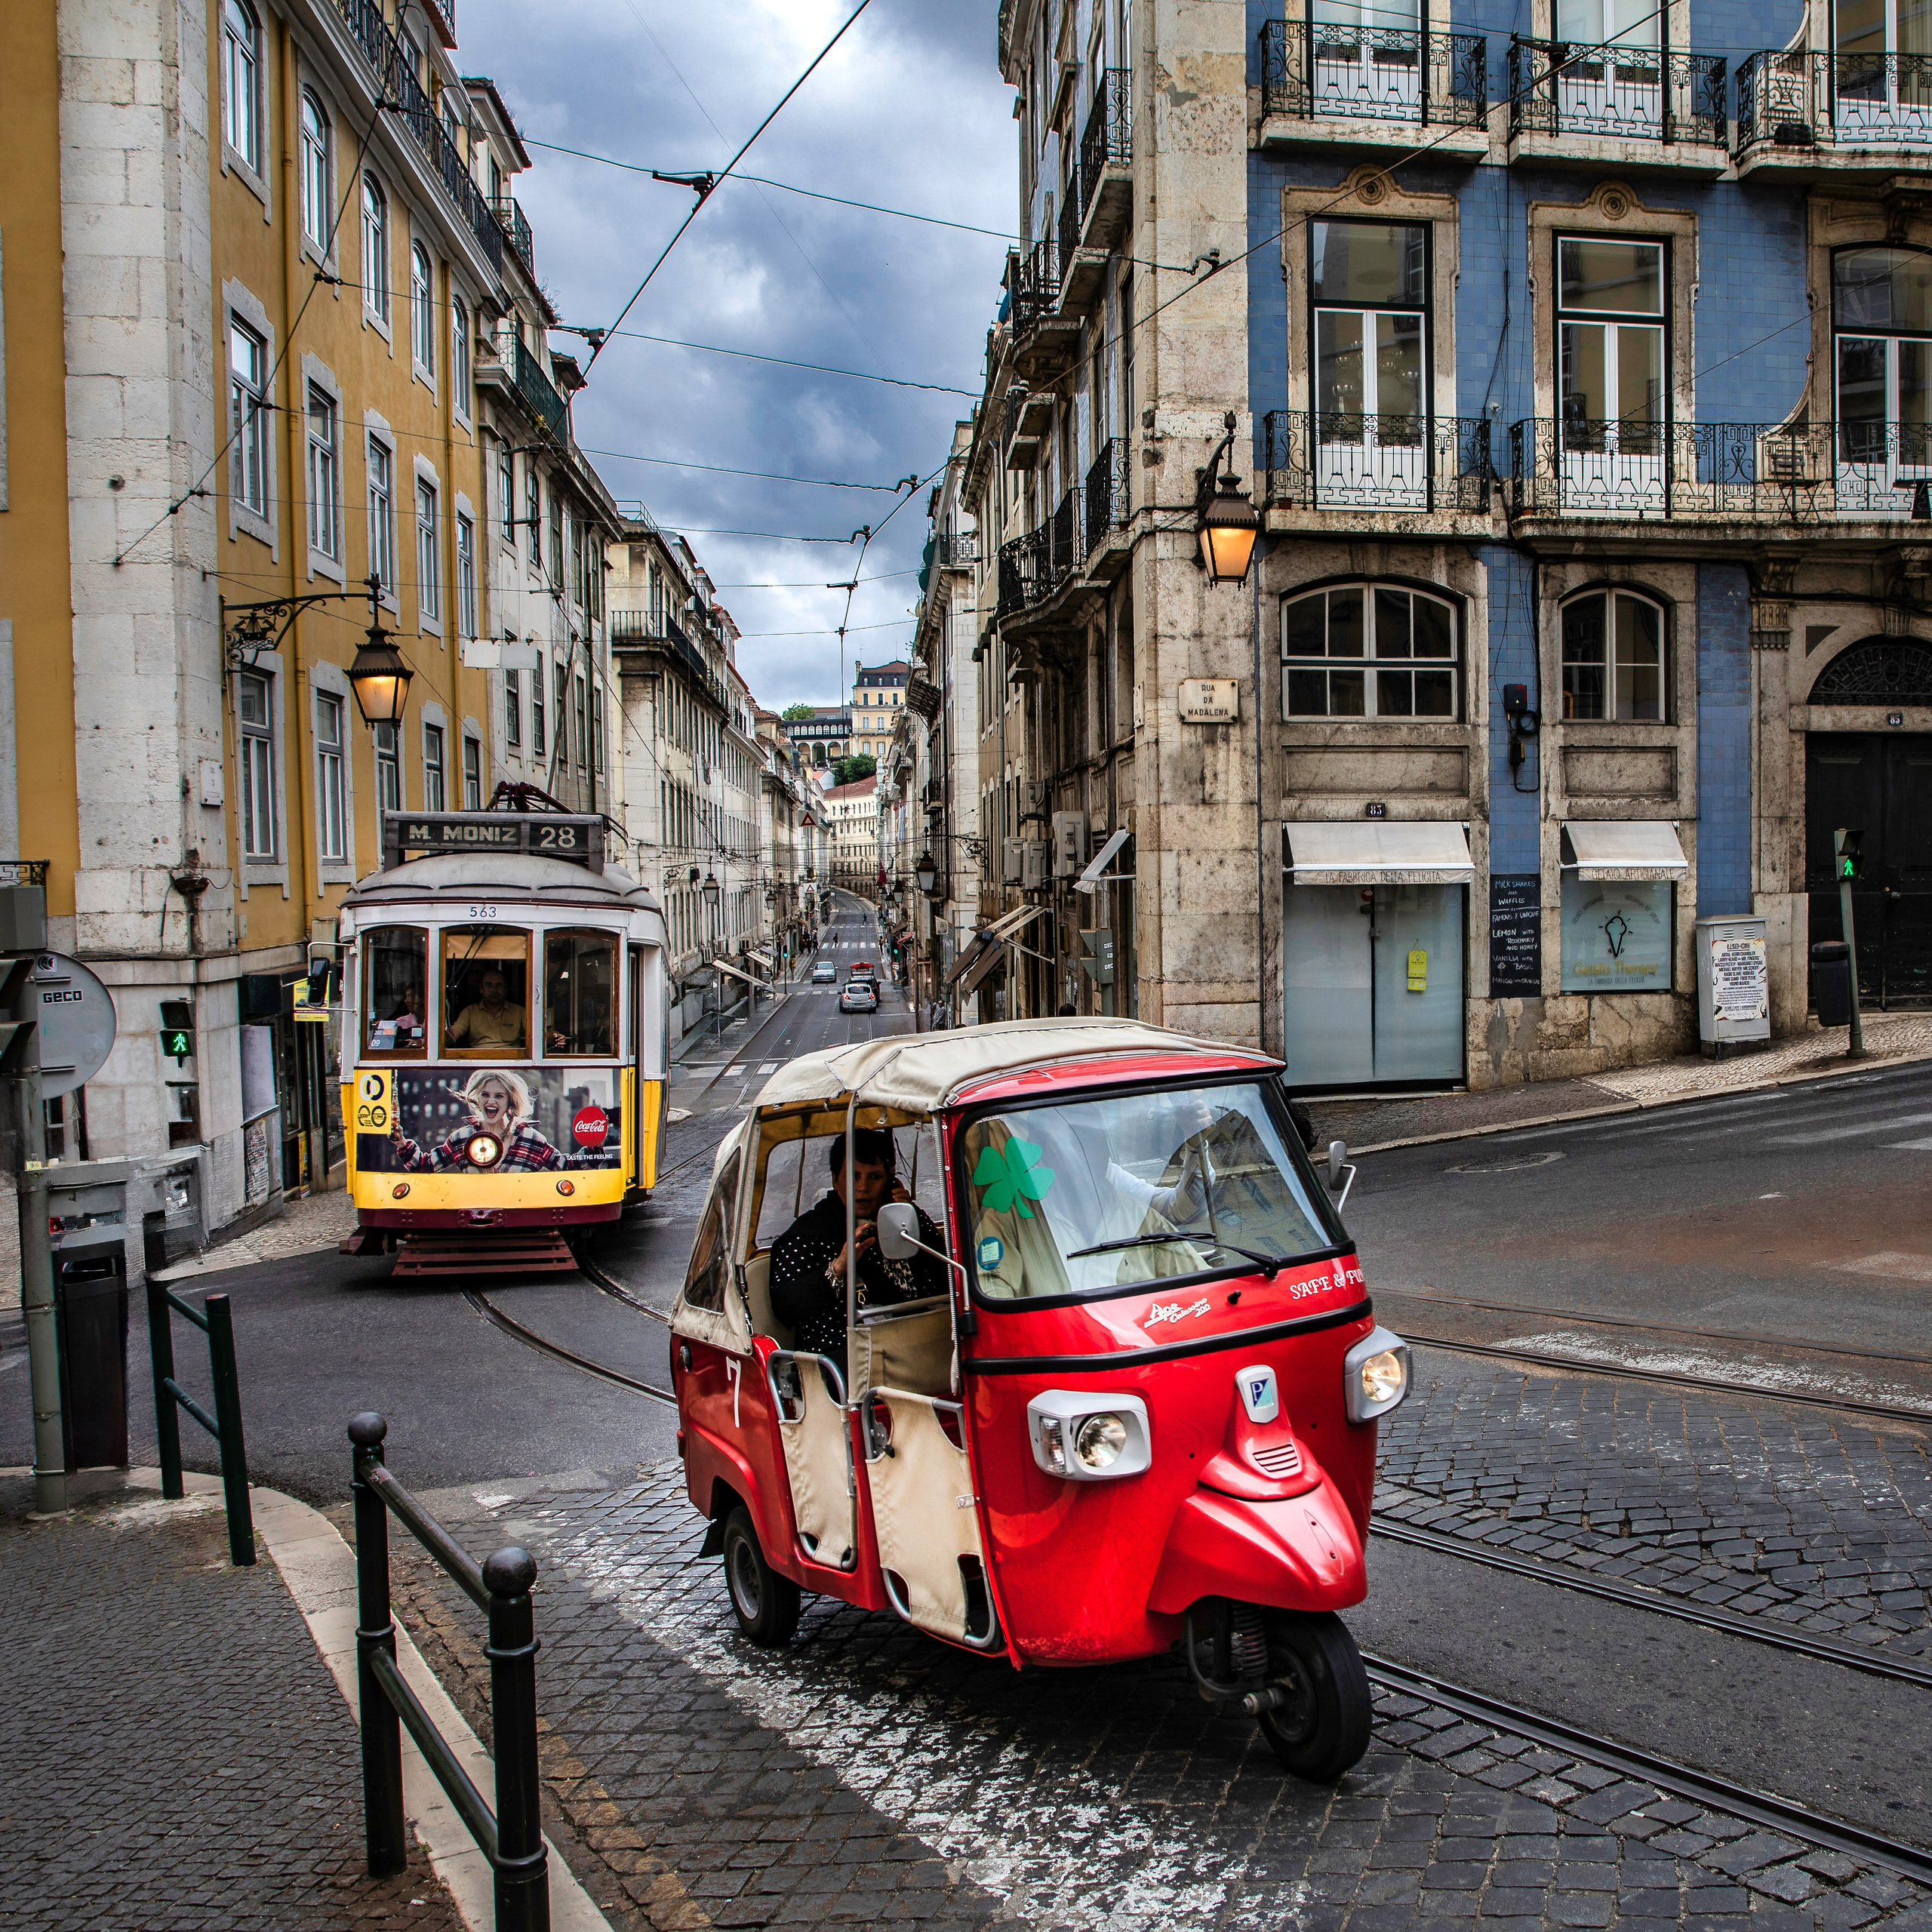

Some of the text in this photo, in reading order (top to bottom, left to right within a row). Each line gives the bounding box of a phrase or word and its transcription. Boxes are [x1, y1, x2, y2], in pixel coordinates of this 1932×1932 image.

[1201, 685, 1215, 695] RUA
[1203, 697, 1213, 707] DA
[1188, 709, 1229, 720] MADALENA
[1370, 804, 1382, 815] 83
[409, 825, 517, 842] M. MONIZ
[540, 826, 576, 848] 28
[1326, 872, 1335, 883] LA
[1339, 871, 1377, 883] FABBRICA
[1380, 871, 1404, 883] DELLA
[1592, 868, 1675, 880] GELATO ARTIGIANALE
[1495, 880, 1511, 889] MILK
[1498, 897, 1525, 906] WAFFLES
[469, 906, 497, 918] 563
[1491, 914, 1512, 923] FAMOUS
[1519, 910, 1540, 919] UNIQUE
[1492, 929, 1516, 937] LEMON
[1574, 960, 1658, 976] Gelato Therapy
[1289, 1275, 1333, 1300] SAFE
[1333, 1273, 1346, 1287] &
[725, 1355, 741, 1429] 7
